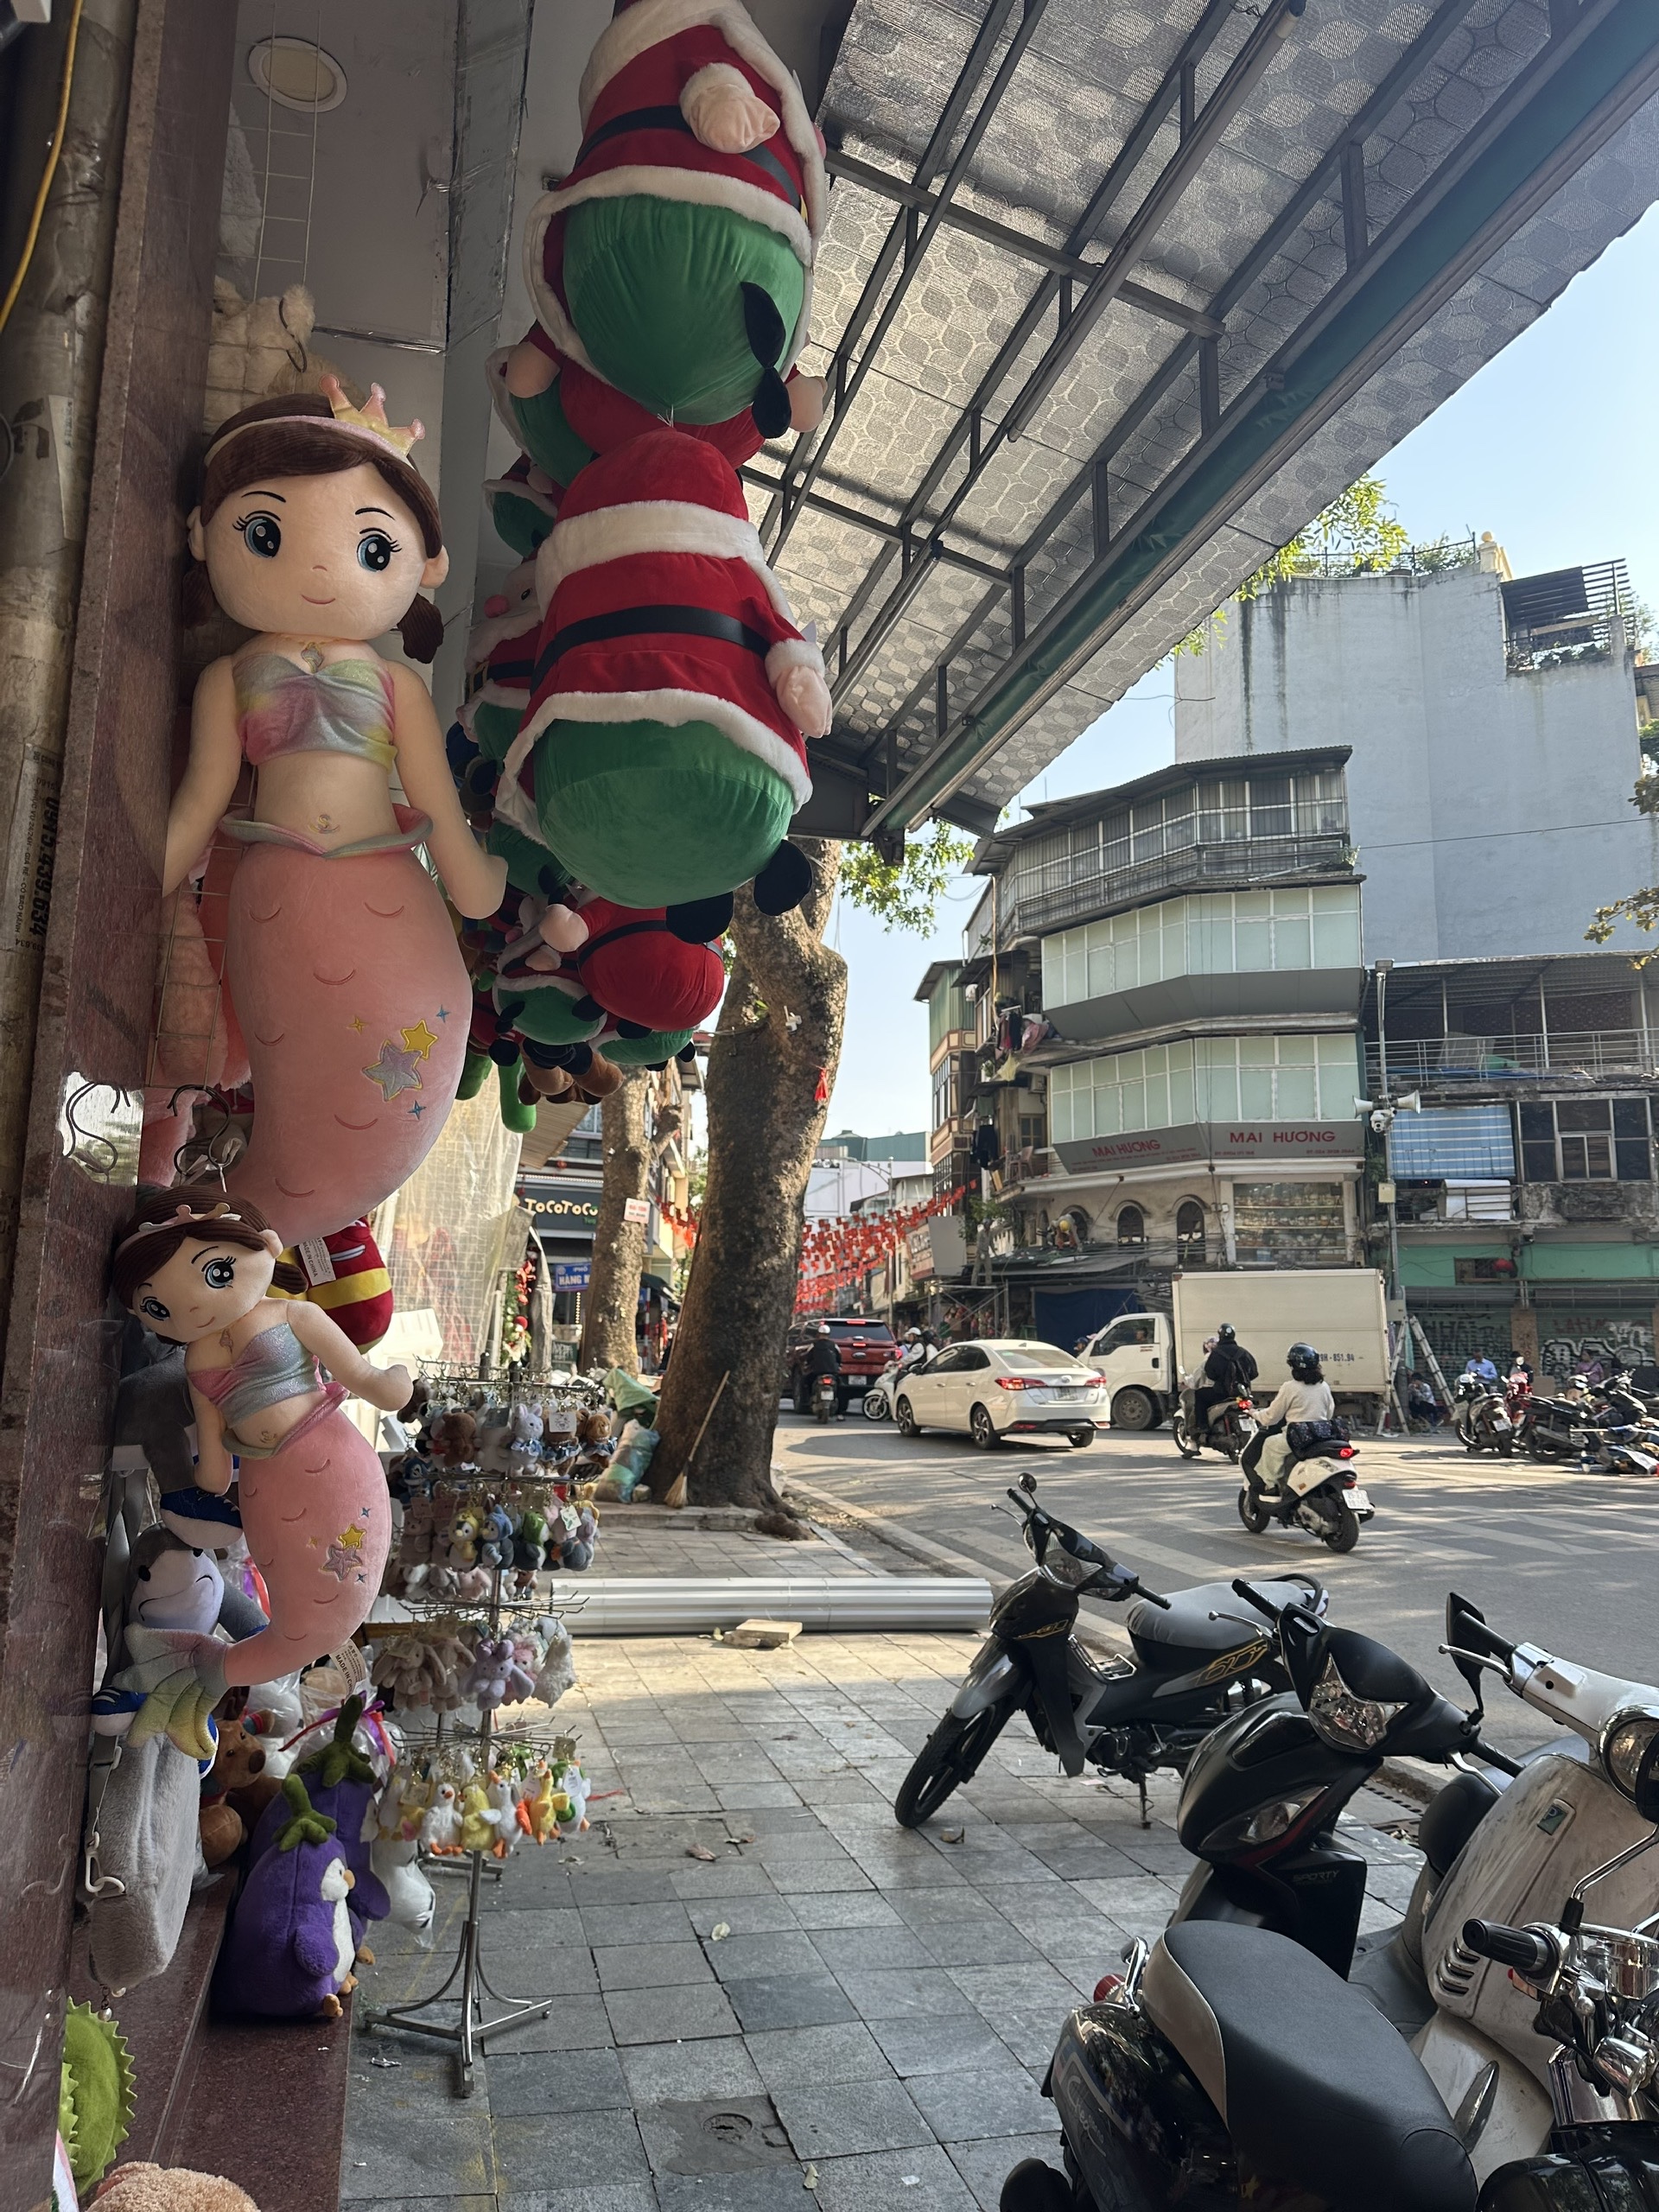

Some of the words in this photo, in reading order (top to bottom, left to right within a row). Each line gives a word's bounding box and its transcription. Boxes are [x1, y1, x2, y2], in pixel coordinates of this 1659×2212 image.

[27, 821, 35, 848] 24/24H
[1230, 1132, 1262, 1143] MAI
[1273, 1130, 1335, 1142] HƯƠNG
[1091, 1145, 1116, 1158] MAI
[1119, 1139, 1161, 1154] HƯƠNG
[308, 1260, 318, 1277] CHINA
[558, 1274, 582, 1286] HÀNG
[335, 1655, 347, 1672] MADE
[344, 1671, 352, 1680] IN
[1293, 1869, 1341, 1883] SPORTY
